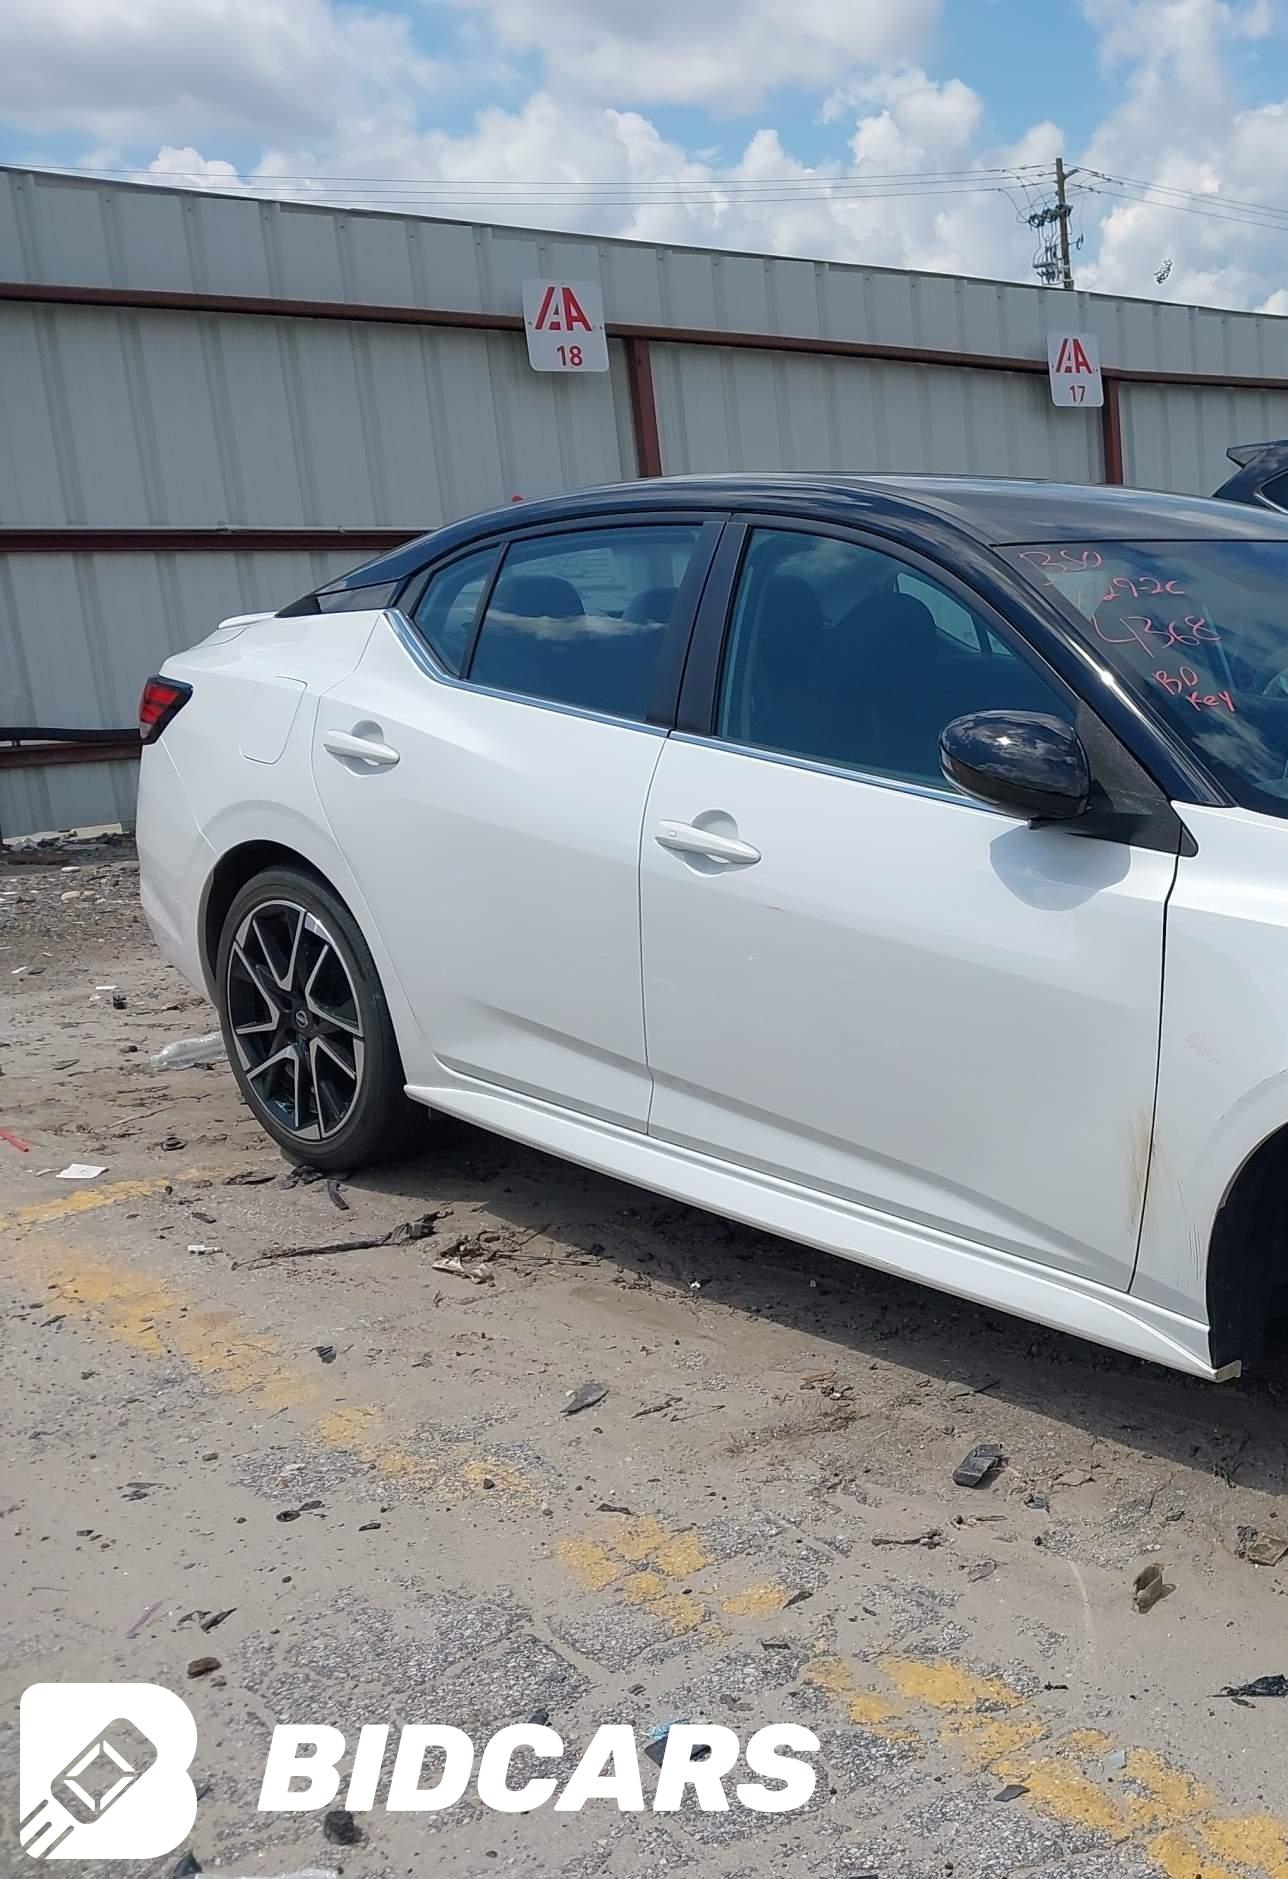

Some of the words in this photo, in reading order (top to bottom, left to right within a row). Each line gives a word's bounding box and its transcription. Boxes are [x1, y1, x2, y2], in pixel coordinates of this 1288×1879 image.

[556, 345, 583, 366] 18
[1069, 385, 1086, 402] 17
[1092, 615, 1222, 659] 4368
